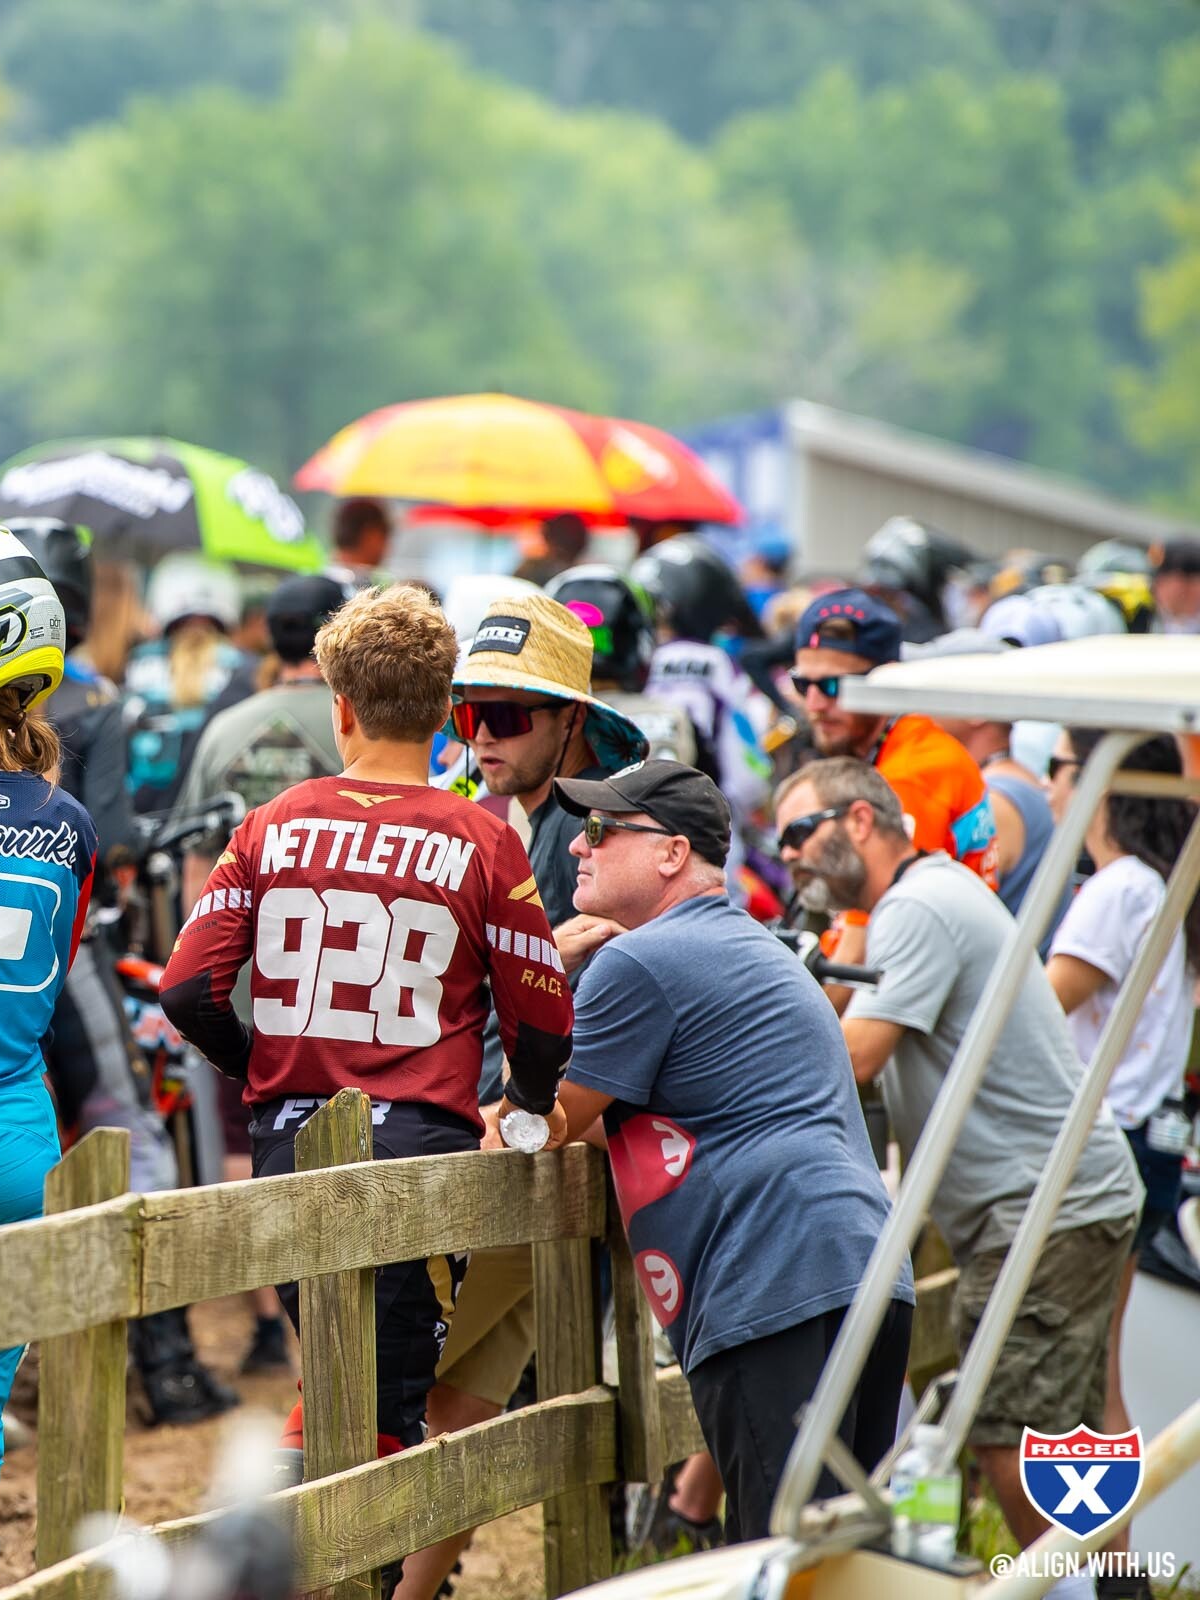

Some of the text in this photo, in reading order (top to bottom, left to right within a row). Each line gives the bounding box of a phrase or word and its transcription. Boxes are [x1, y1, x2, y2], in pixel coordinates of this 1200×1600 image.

[260, 818, 476, 892] NETTLETON
[254, 888, 460, 1048] 928
[520, 968, 563, 998] RACE
[273, 1099, 392, 1130] FR
